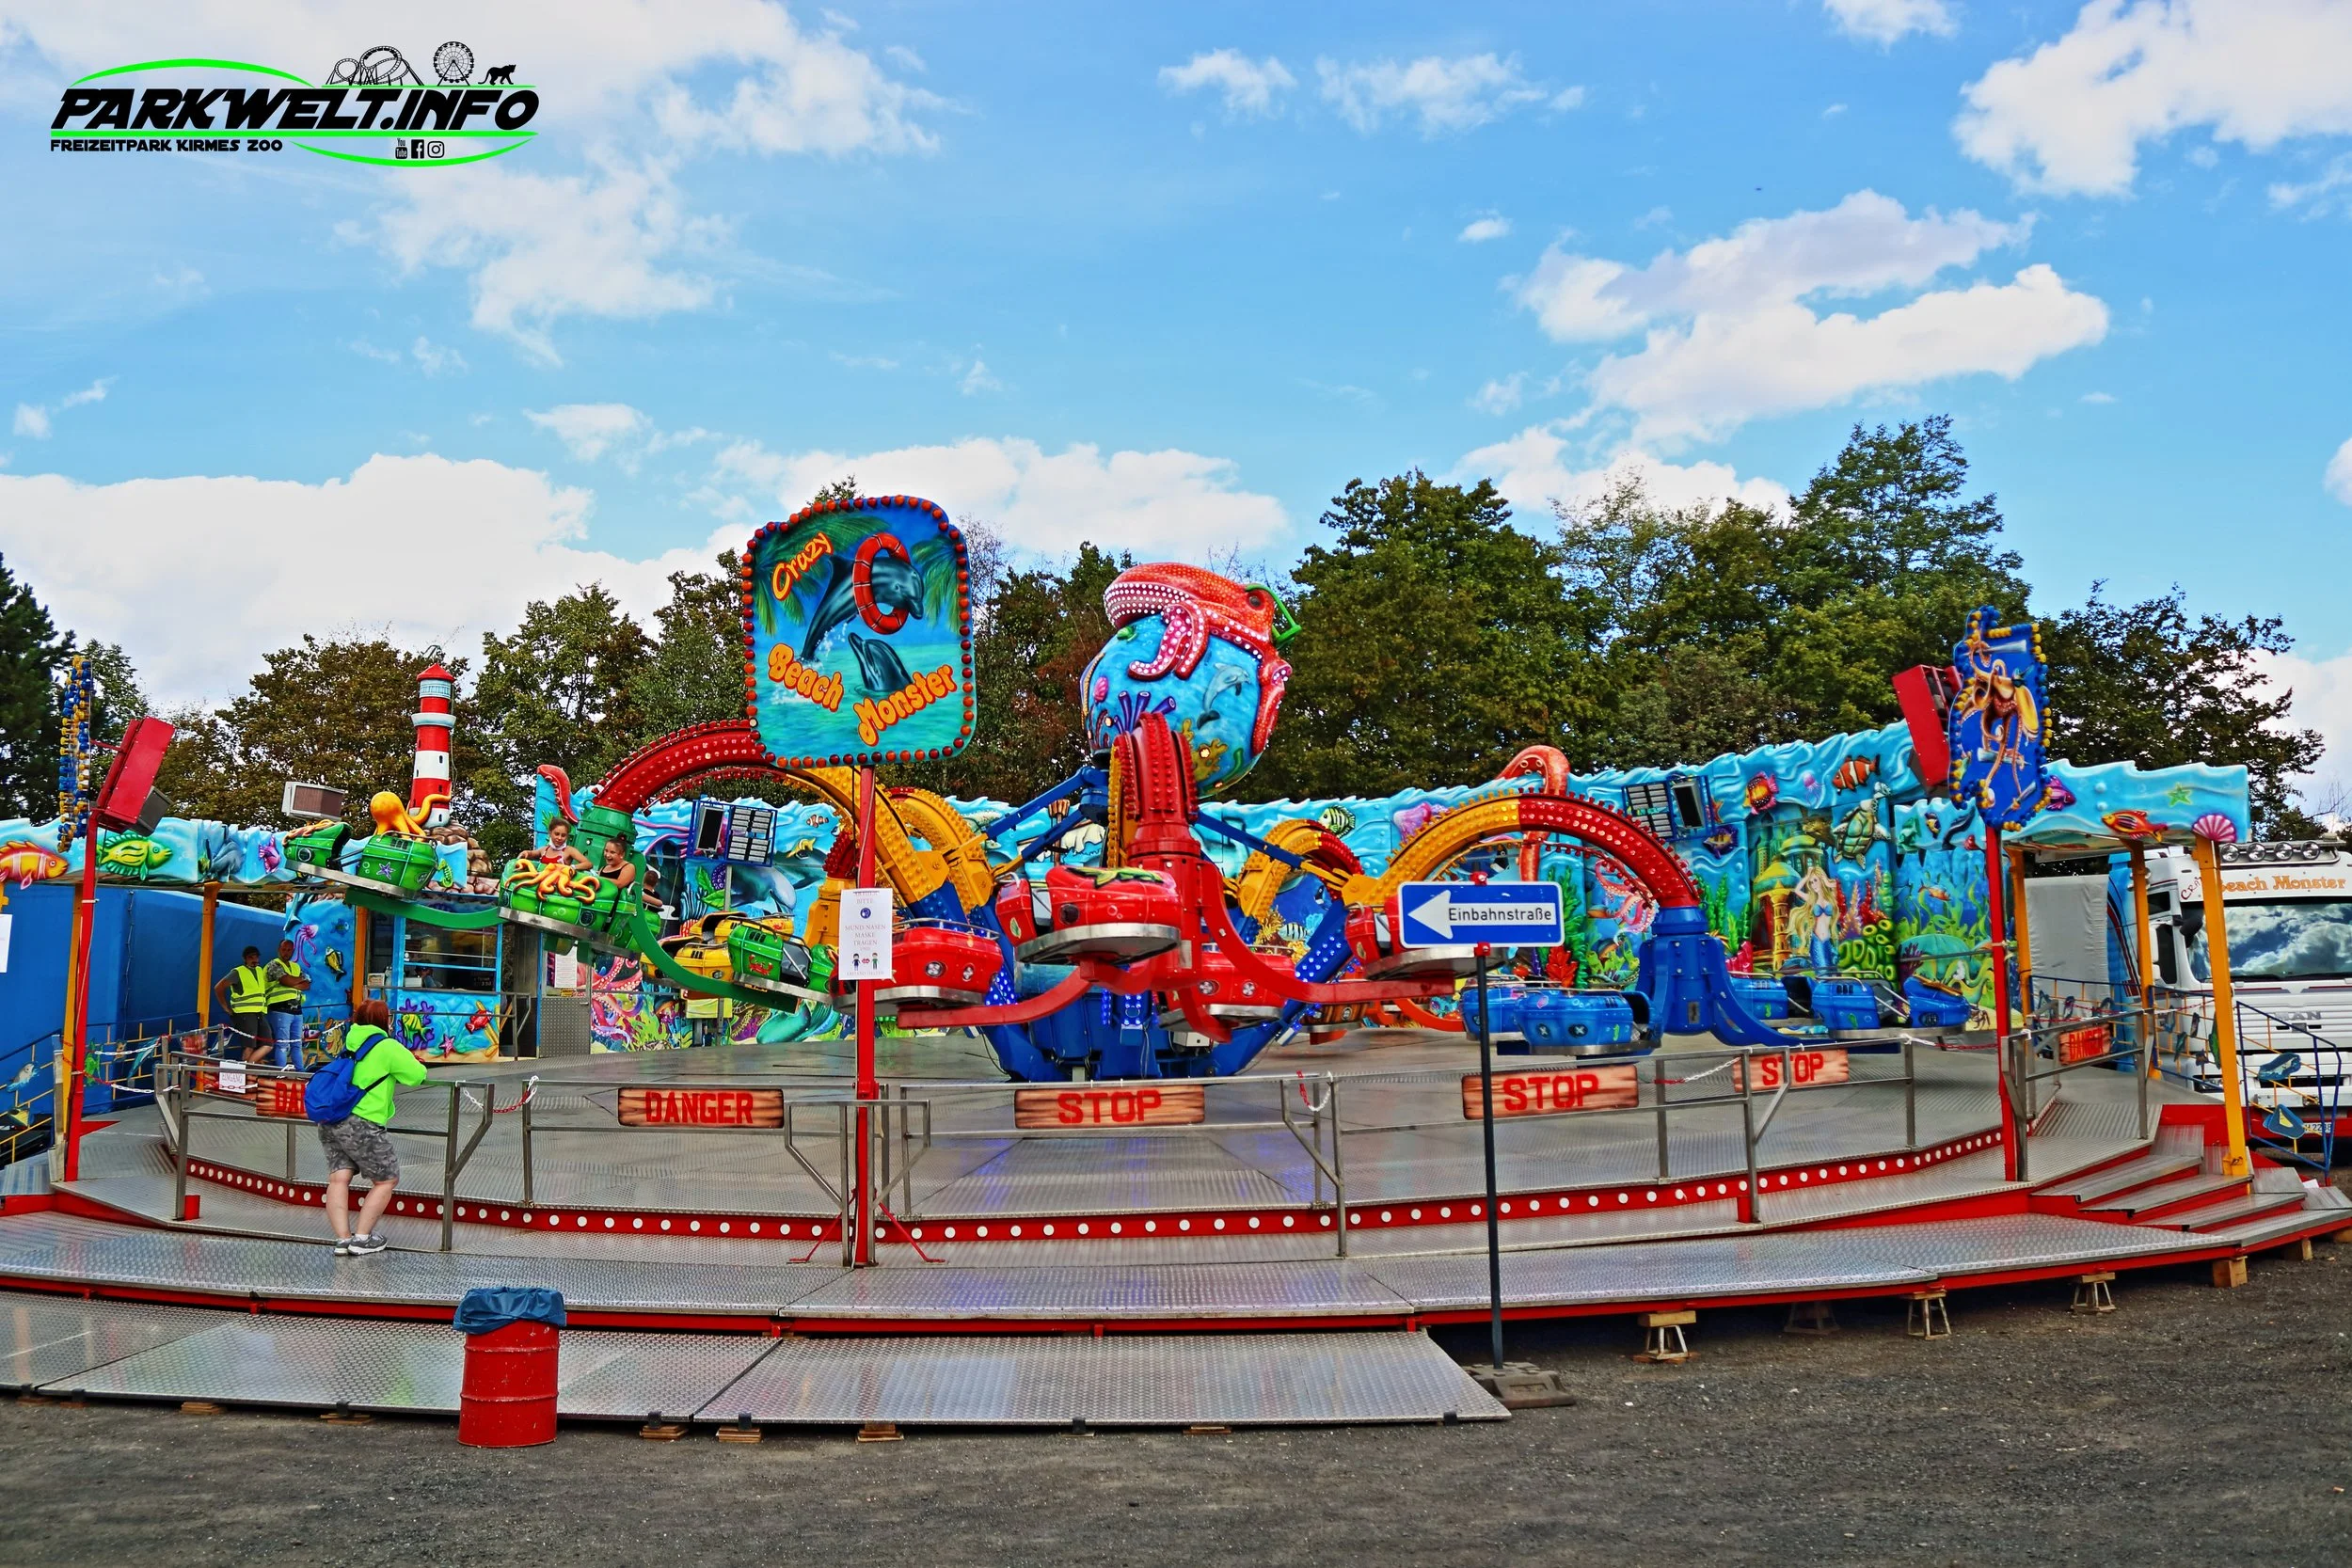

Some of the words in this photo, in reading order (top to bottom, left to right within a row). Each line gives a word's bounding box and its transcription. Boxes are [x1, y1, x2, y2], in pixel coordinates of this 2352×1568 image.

[771, 531, 834, 601] Crazy
[768, 643, 844, 712] Beach
[852, 664, 958, 747] Monster
[2272, 875, 2346, 890] Monster
[1449, 908, 1552, 921] Einbahnstraße
[645, 1091, 754, 1124] DANGER
[1057, 1089, 1162, 1124] STOP
[1502, 1073, 1599, 1111] STOP
